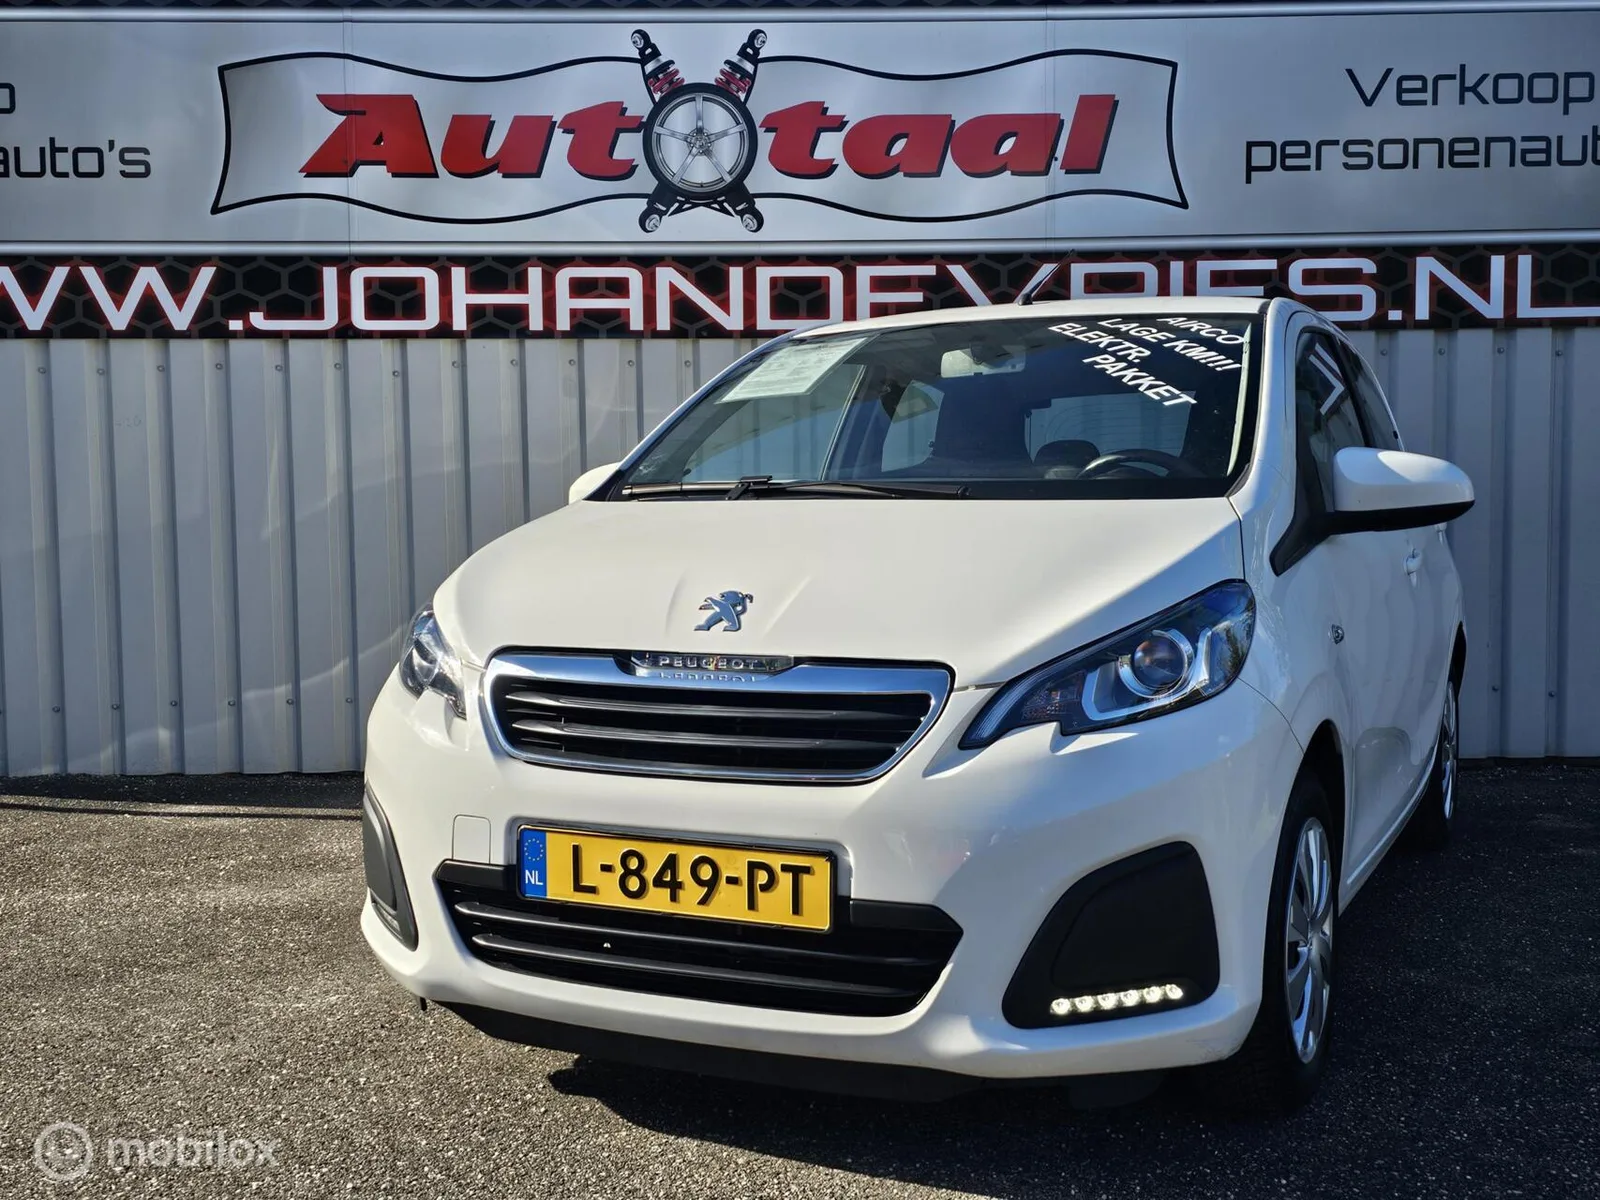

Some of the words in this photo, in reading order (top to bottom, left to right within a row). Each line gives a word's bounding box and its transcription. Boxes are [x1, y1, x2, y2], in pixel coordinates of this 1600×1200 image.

[1345, 64, 1595, 115] Verkoop
[1048, 322, 1152, 363] ELEKTR.
[1097, 318, 1177, 342] LAGE
[1162, 339, 1242, 372] KM!!!
[1155, 316, 1244, 345] AIRCO
[1082, 354, 1198, 406] PAKKET
[658, 655, 758, 670] PEUGEOT
[524, 869, 544, 886] NL
[571, 843, 813, 916] L-849-PT
